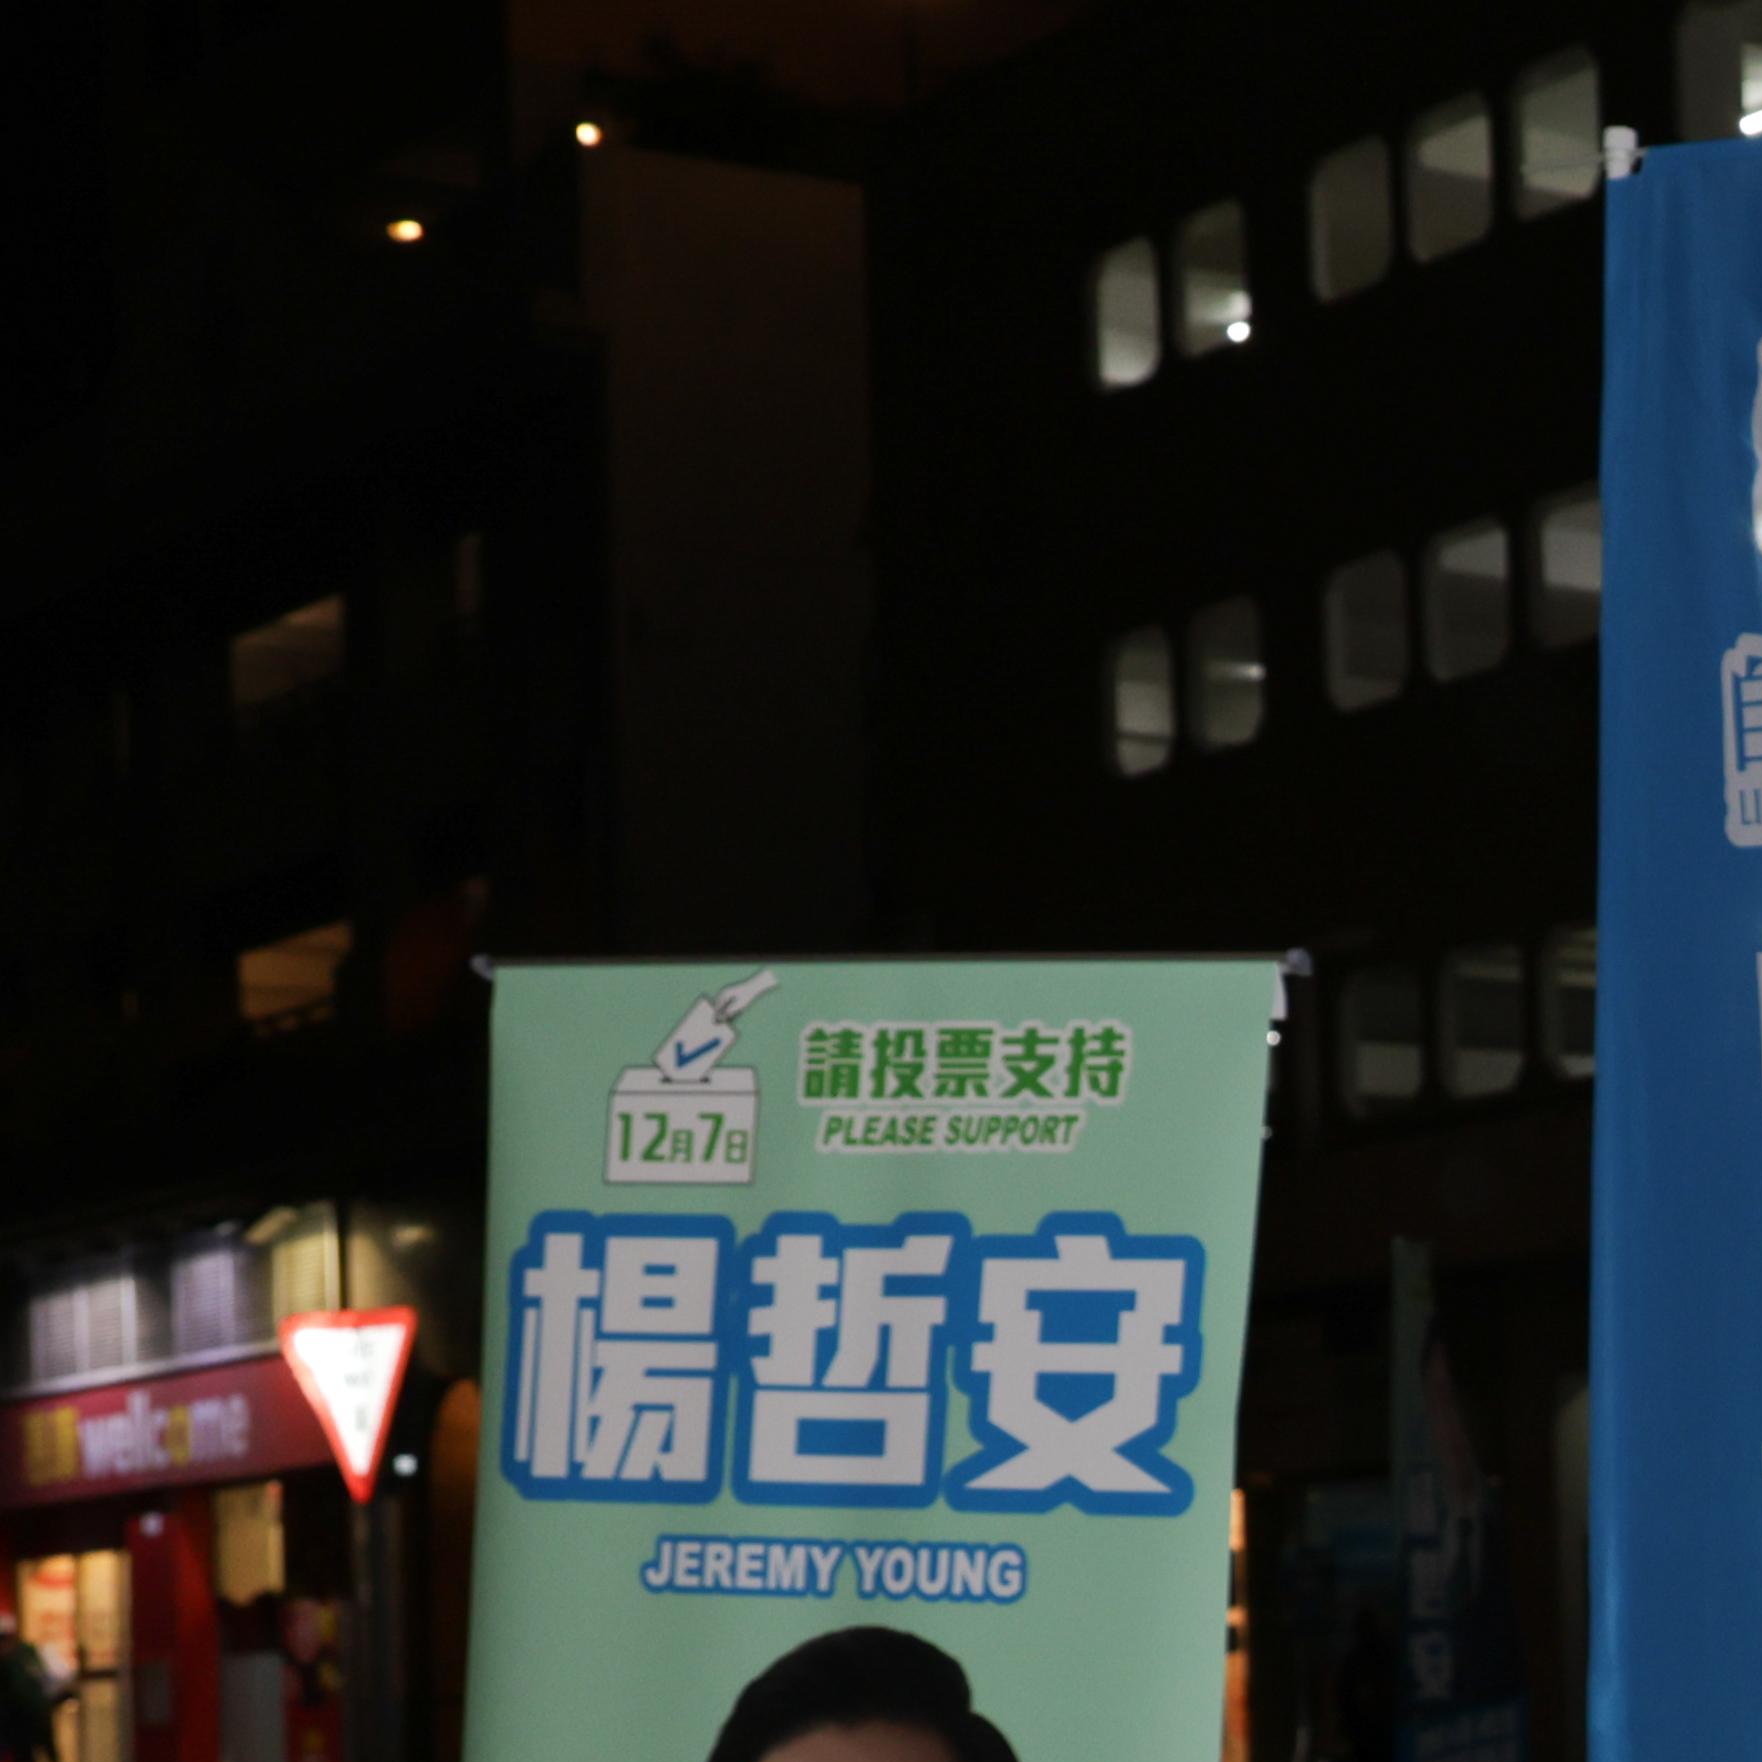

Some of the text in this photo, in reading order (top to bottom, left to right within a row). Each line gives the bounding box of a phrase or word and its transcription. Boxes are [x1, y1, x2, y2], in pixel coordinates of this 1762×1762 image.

[804, 1025, 1128, 1099] 請投票支持
[617, 1112, 749, 1164] 12月7日
[822, 1113, 1080, 1147] PLEASE SUPPORT
[512, 1230, 1190, 1495] 楊哲安
[645, 1542, 1023, 1598] JEREMY YOUNG
